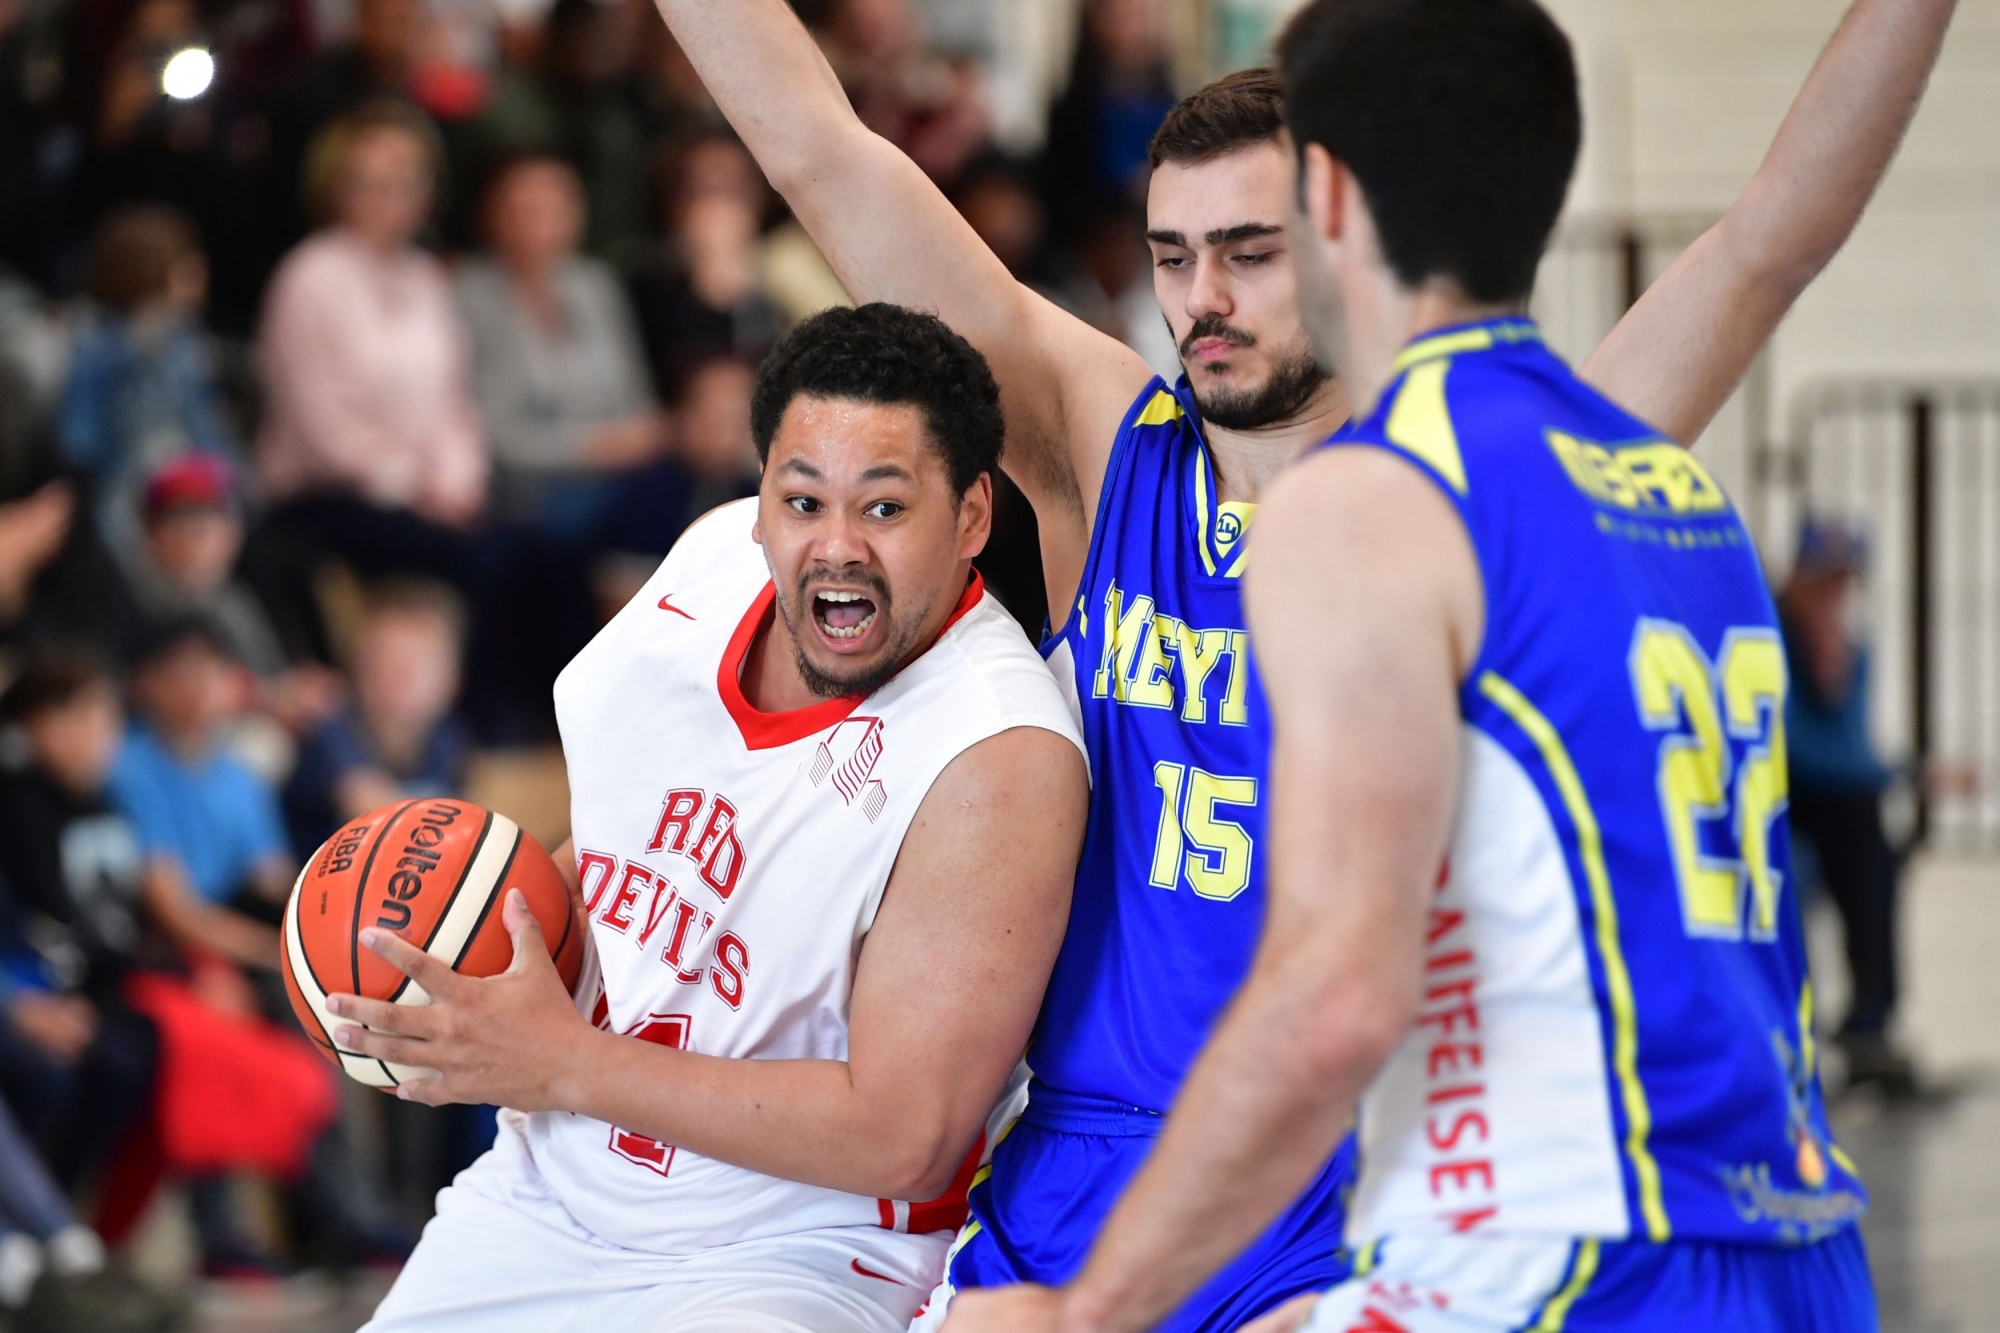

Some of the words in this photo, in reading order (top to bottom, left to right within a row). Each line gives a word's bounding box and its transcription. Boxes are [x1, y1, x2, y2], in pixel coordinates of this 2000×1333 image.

[645, 787, 747, 904] RED
[1149, 759, 1258, 902] 15
[1626, 614, 1790, 943] 22
[328, 824, 372, 875] FIBA
[376, 803, 462, 931] molten
[1417, 855, 1498, 1236] AIFEISE
